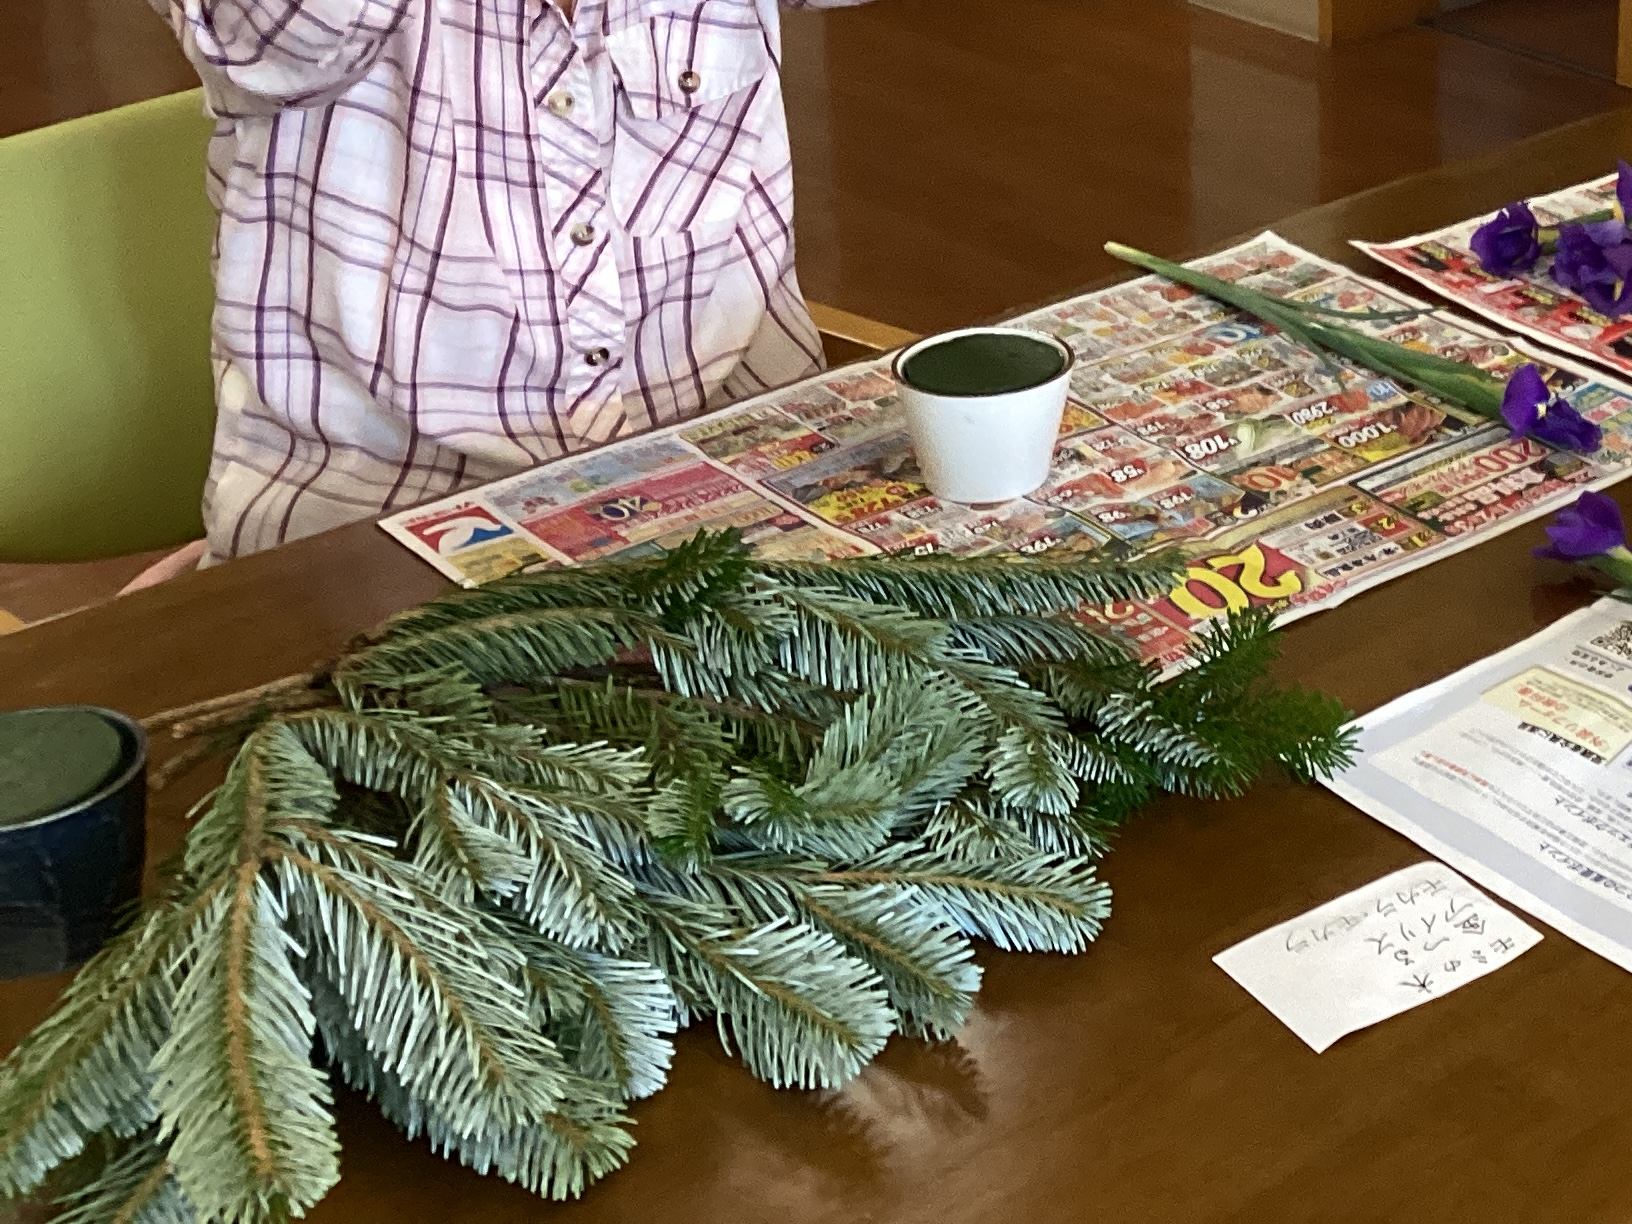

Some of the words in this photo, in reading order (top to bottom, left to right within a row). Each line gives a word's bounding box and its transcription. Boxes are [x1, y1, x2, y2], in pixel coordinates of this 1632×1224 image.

[1169, 544, 1302, 618] 20
[1363, 897, 1474, 955] アイリス
